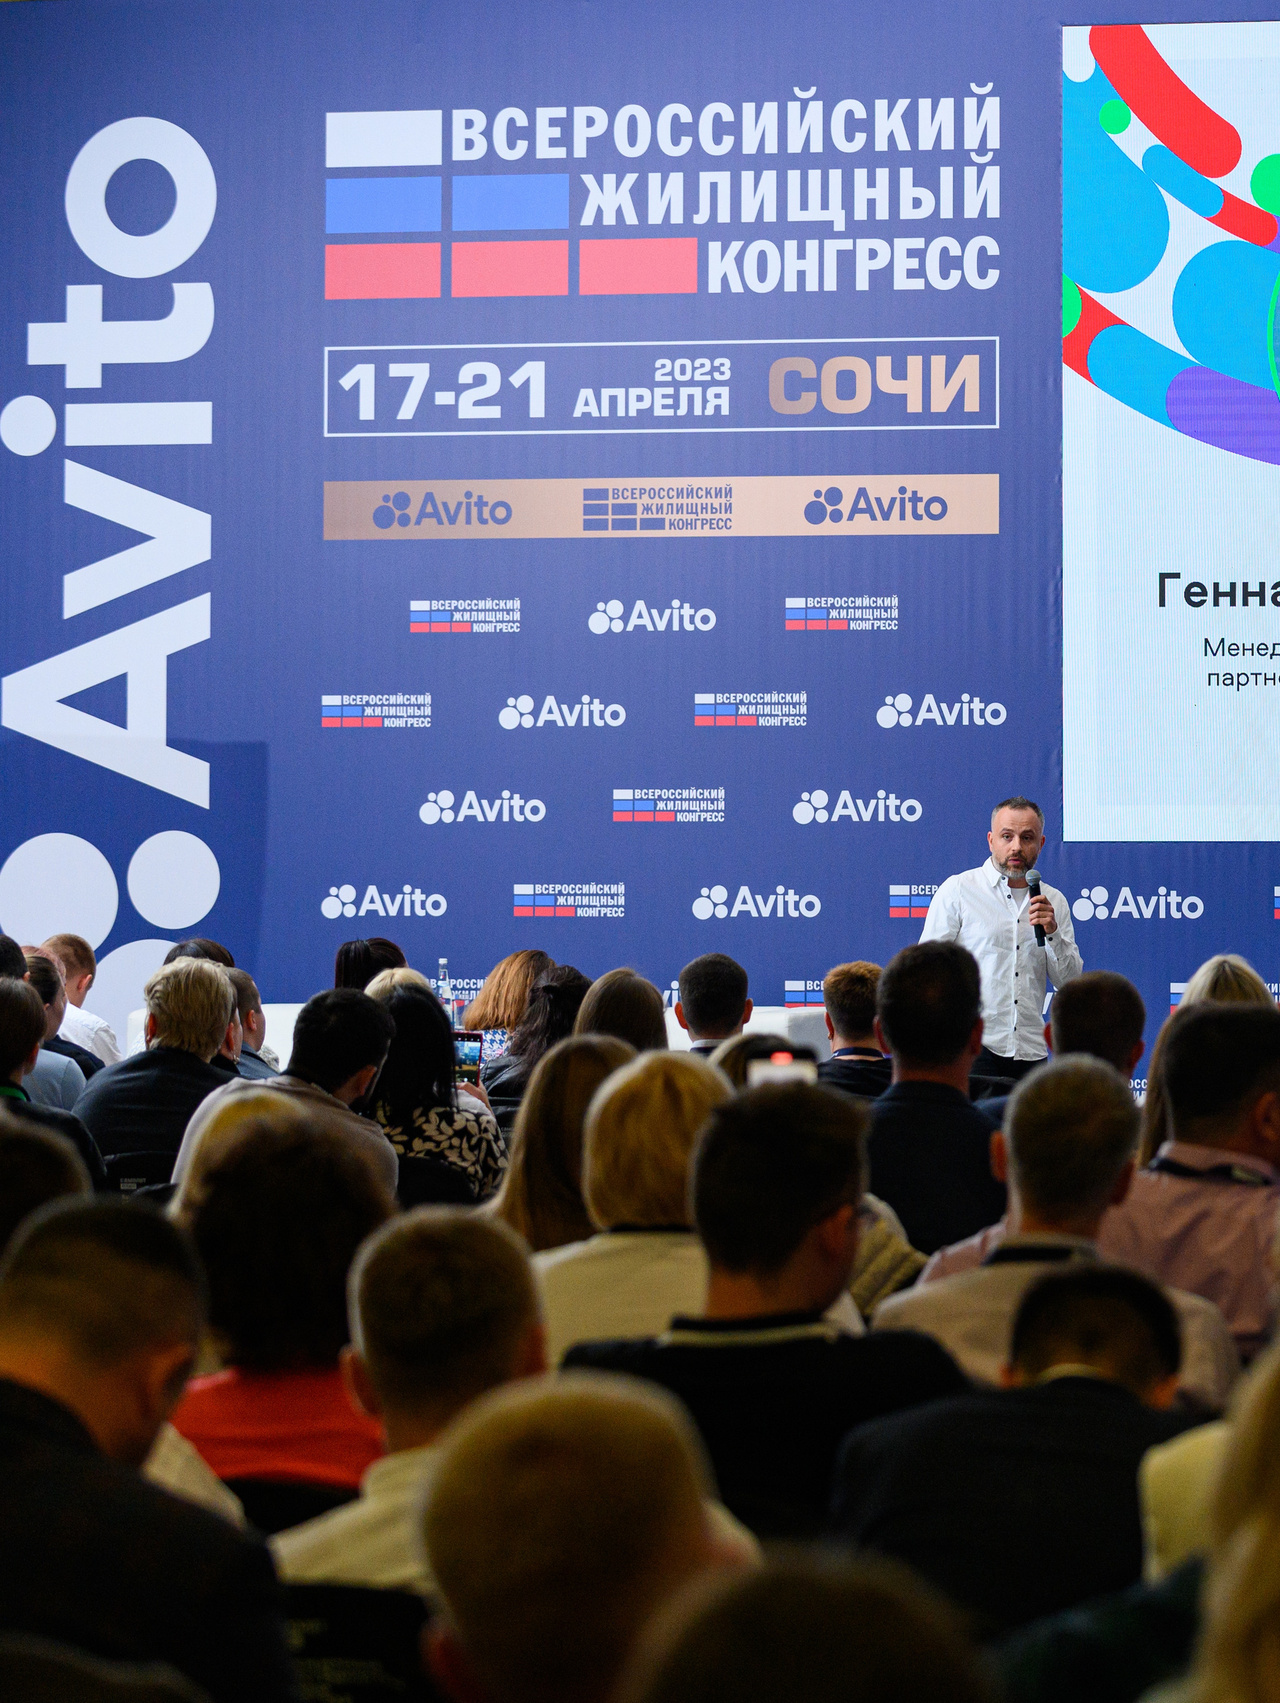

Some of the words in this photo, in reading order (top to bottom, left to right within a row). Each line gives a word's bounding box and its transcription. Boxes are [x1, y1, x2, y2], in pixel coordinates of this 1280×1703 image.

[452, 83, 1000, 163] ВСЕРОССИЙСКИЙ
[577, 149, 1000, 231] ЖИЛИЩНЫЙ
[708, 236, 999, 293] КОНГРЕСС
[655, 358, 731, 381] 2023
[339, 361, 545, 420] 17-21
[573, 387, 729, 417] АПРЕЛЯ
[769, 355, 979, 414] СОЧИ
[0, 117, 217, 809] Avito
[612, 484, 732, 502] ВСЕРОССИЙСКИЙ
[414, 491, 512, 526] Avito
[642, 500, 732, 517] ЖИЛИЩНЫЙ
[847, 486, 948, 521] Avito
[669, 518, 732, 530] КОНГРЕСС
[432, 598, 520, 612] ВСЕРОССИЙСКИЙ
[808, 595, 898, 610] ВСЕРОССИЙСКИЙ
[453, 608, 520, 622] ЖИЛИЩНЫЙ
[626, 599, 716, 631] Avito
[830, 606, 898, 620] ЖИЛИЩНЫЙ
[473, 623, 520, 632] КОНГРЕСС
[850, 620, 898, 630] КОНГРЕСС
[343, 693, 431, 706] ВСЕРОССИЙСКИЙ
[717, 691, 806, 705] ВСЕРОССИЙСКИЙ
[364, 702, 431, 717] ЖИЛИЩНЫЙ
[536, 695, 626, 726] Avito
[739, 705, 806, 716] ЖИЛИЩНЫЙ
[915, 693, 1006, 725] Avito
[384, 718, 431, 727] КОНГРЕСС
[759, 717, 806, 726] КОНГРЕСС
[635, 787, 724, 801] ВСЕРОССИЙСКИЙ
[457, 790, 546, 822] Avito
[657, 801, 724, 812] ЖИЛИЩНЫЙ
[831, 790, 922, 821] Avito
[677, 812, 724, 821] КОНГРЕСС
[535, 882, 624, 896] ВСЕРОССИЙСКИЙ
[911, 885, 938, 895] ВСЕР
[358, 885, 447, 916] Avito
[557, 892, 624, 907] ЖИЛИЩНЫЙ
[730, 885, 821, 917] Avito
[1111, 887, 1203, 919] Avito
[577, 907, 624, 917] КОНГРЕСС
